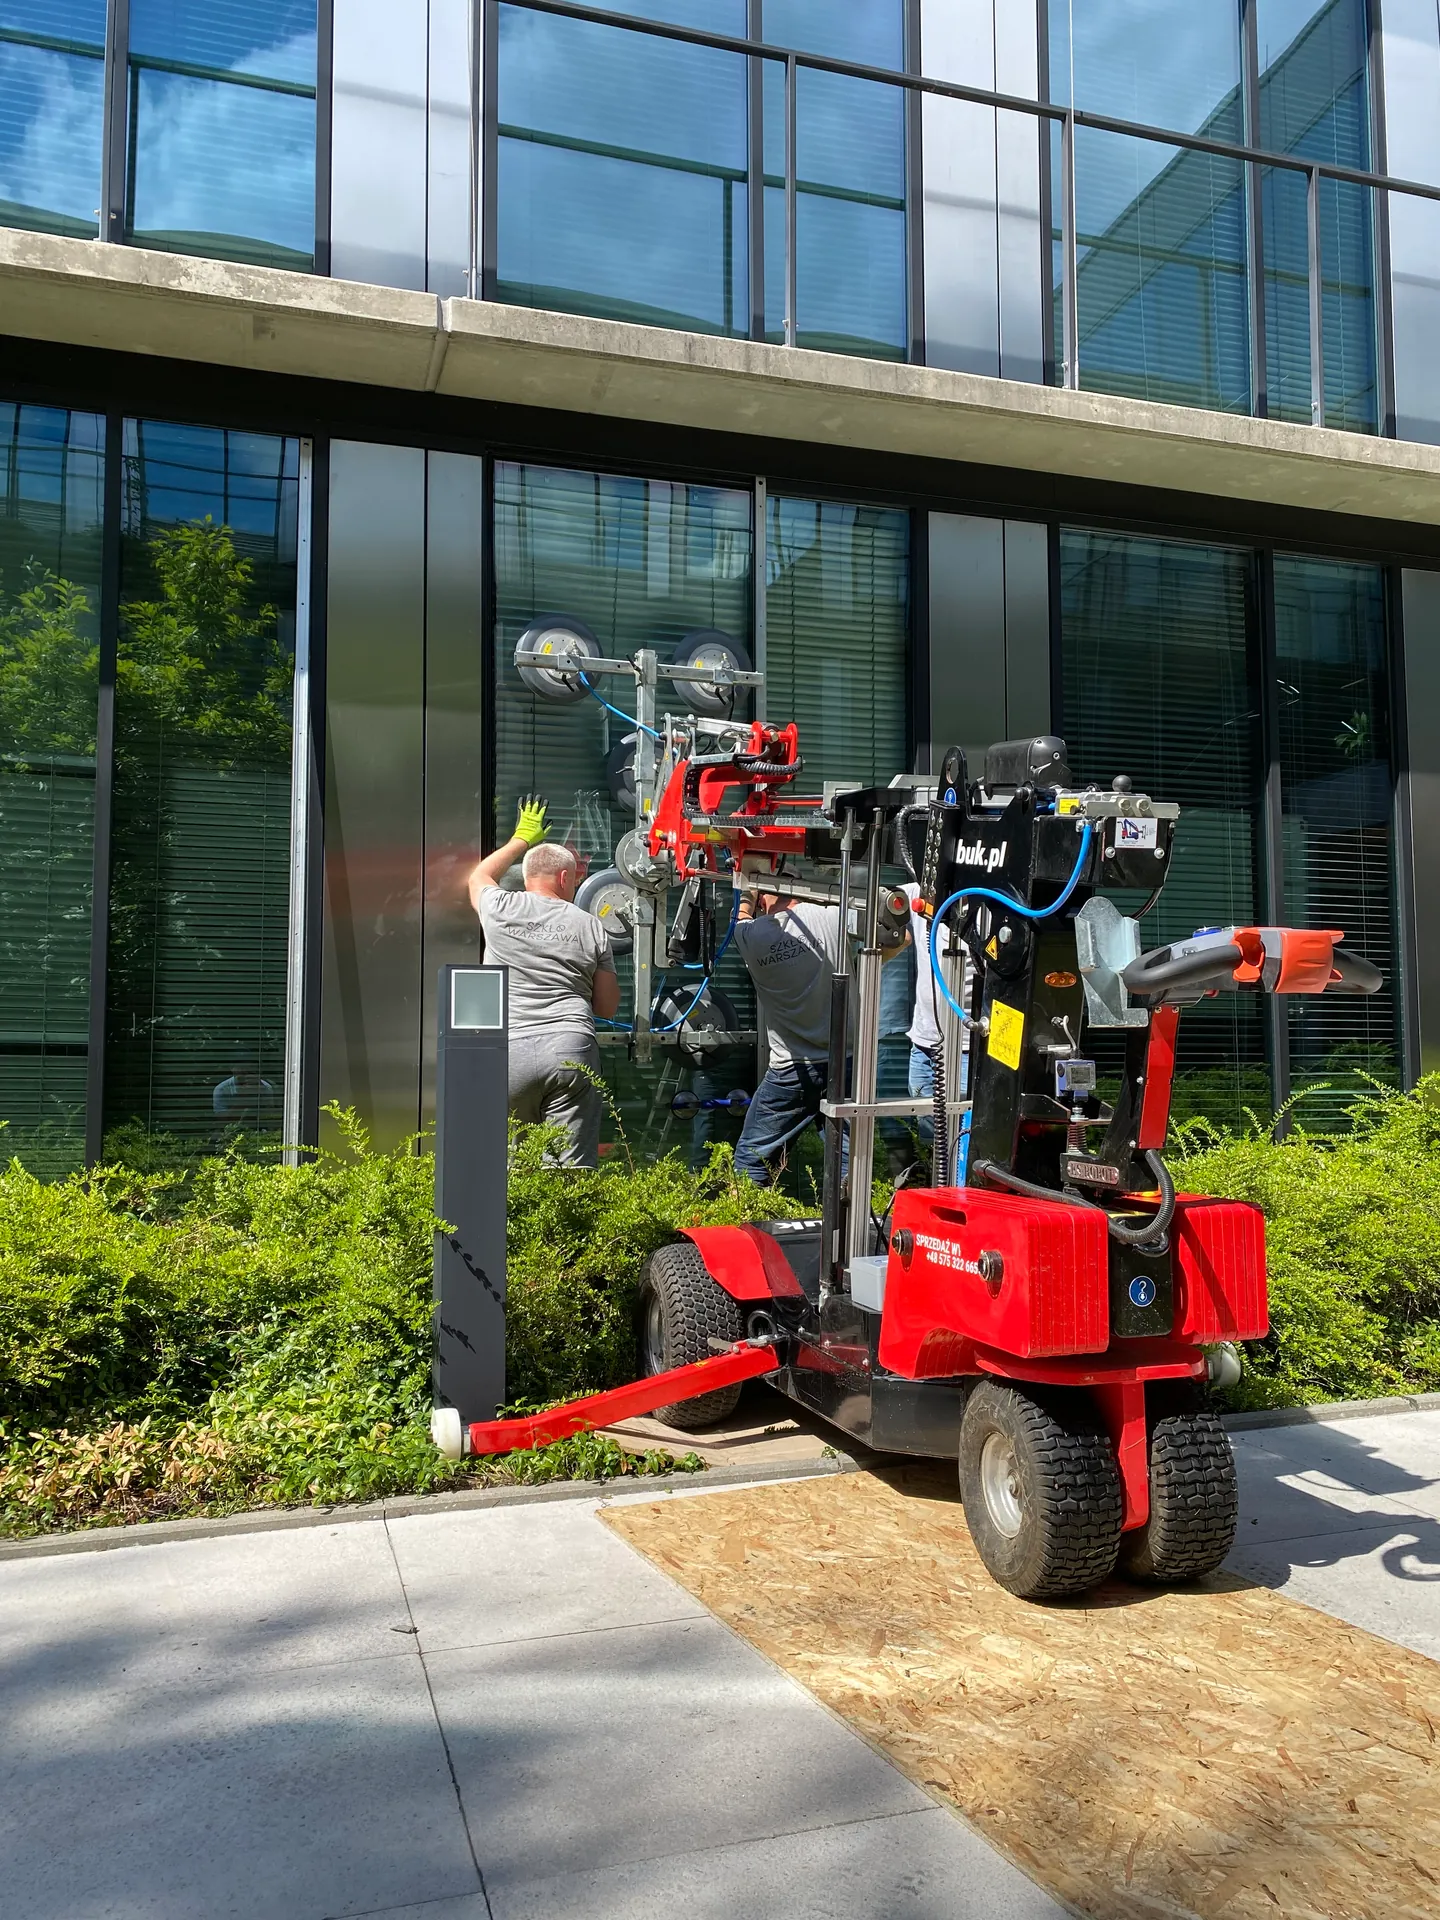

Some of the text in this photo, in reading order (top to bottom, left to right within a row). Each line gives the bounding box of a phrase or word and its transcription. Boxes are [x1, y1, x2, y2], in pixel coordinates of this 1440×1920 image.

[955, 838, 1008, 873] buk.pl
[507, 926, 580, 944] WARSZAWA
[915, 1233, 951, 1254] SPRZEDAŻ
[926, 1251, 979, 1275] +48 575 322 665
